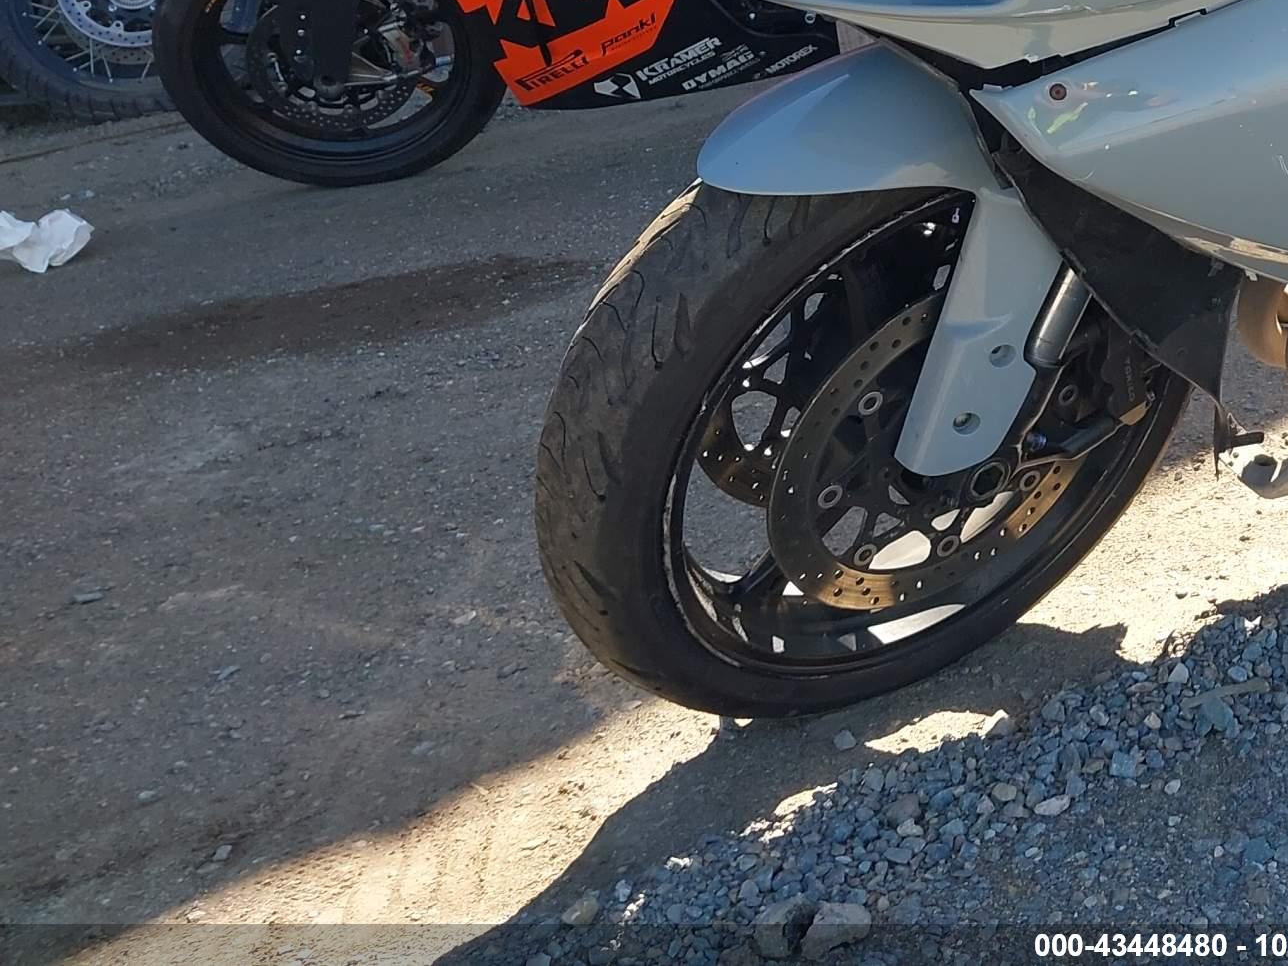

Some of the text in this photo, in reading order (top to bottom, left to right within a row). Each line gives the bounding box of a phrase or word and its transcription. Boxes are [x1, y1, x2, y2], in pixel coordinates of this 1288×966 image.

[514, 49, 590, 91] PIRELLI
[649, 51, 716, 85] MOTORCYCLES
[682, 51, 754, 91] DYMAG
[764, 44, 818, 74] MOTOREX
